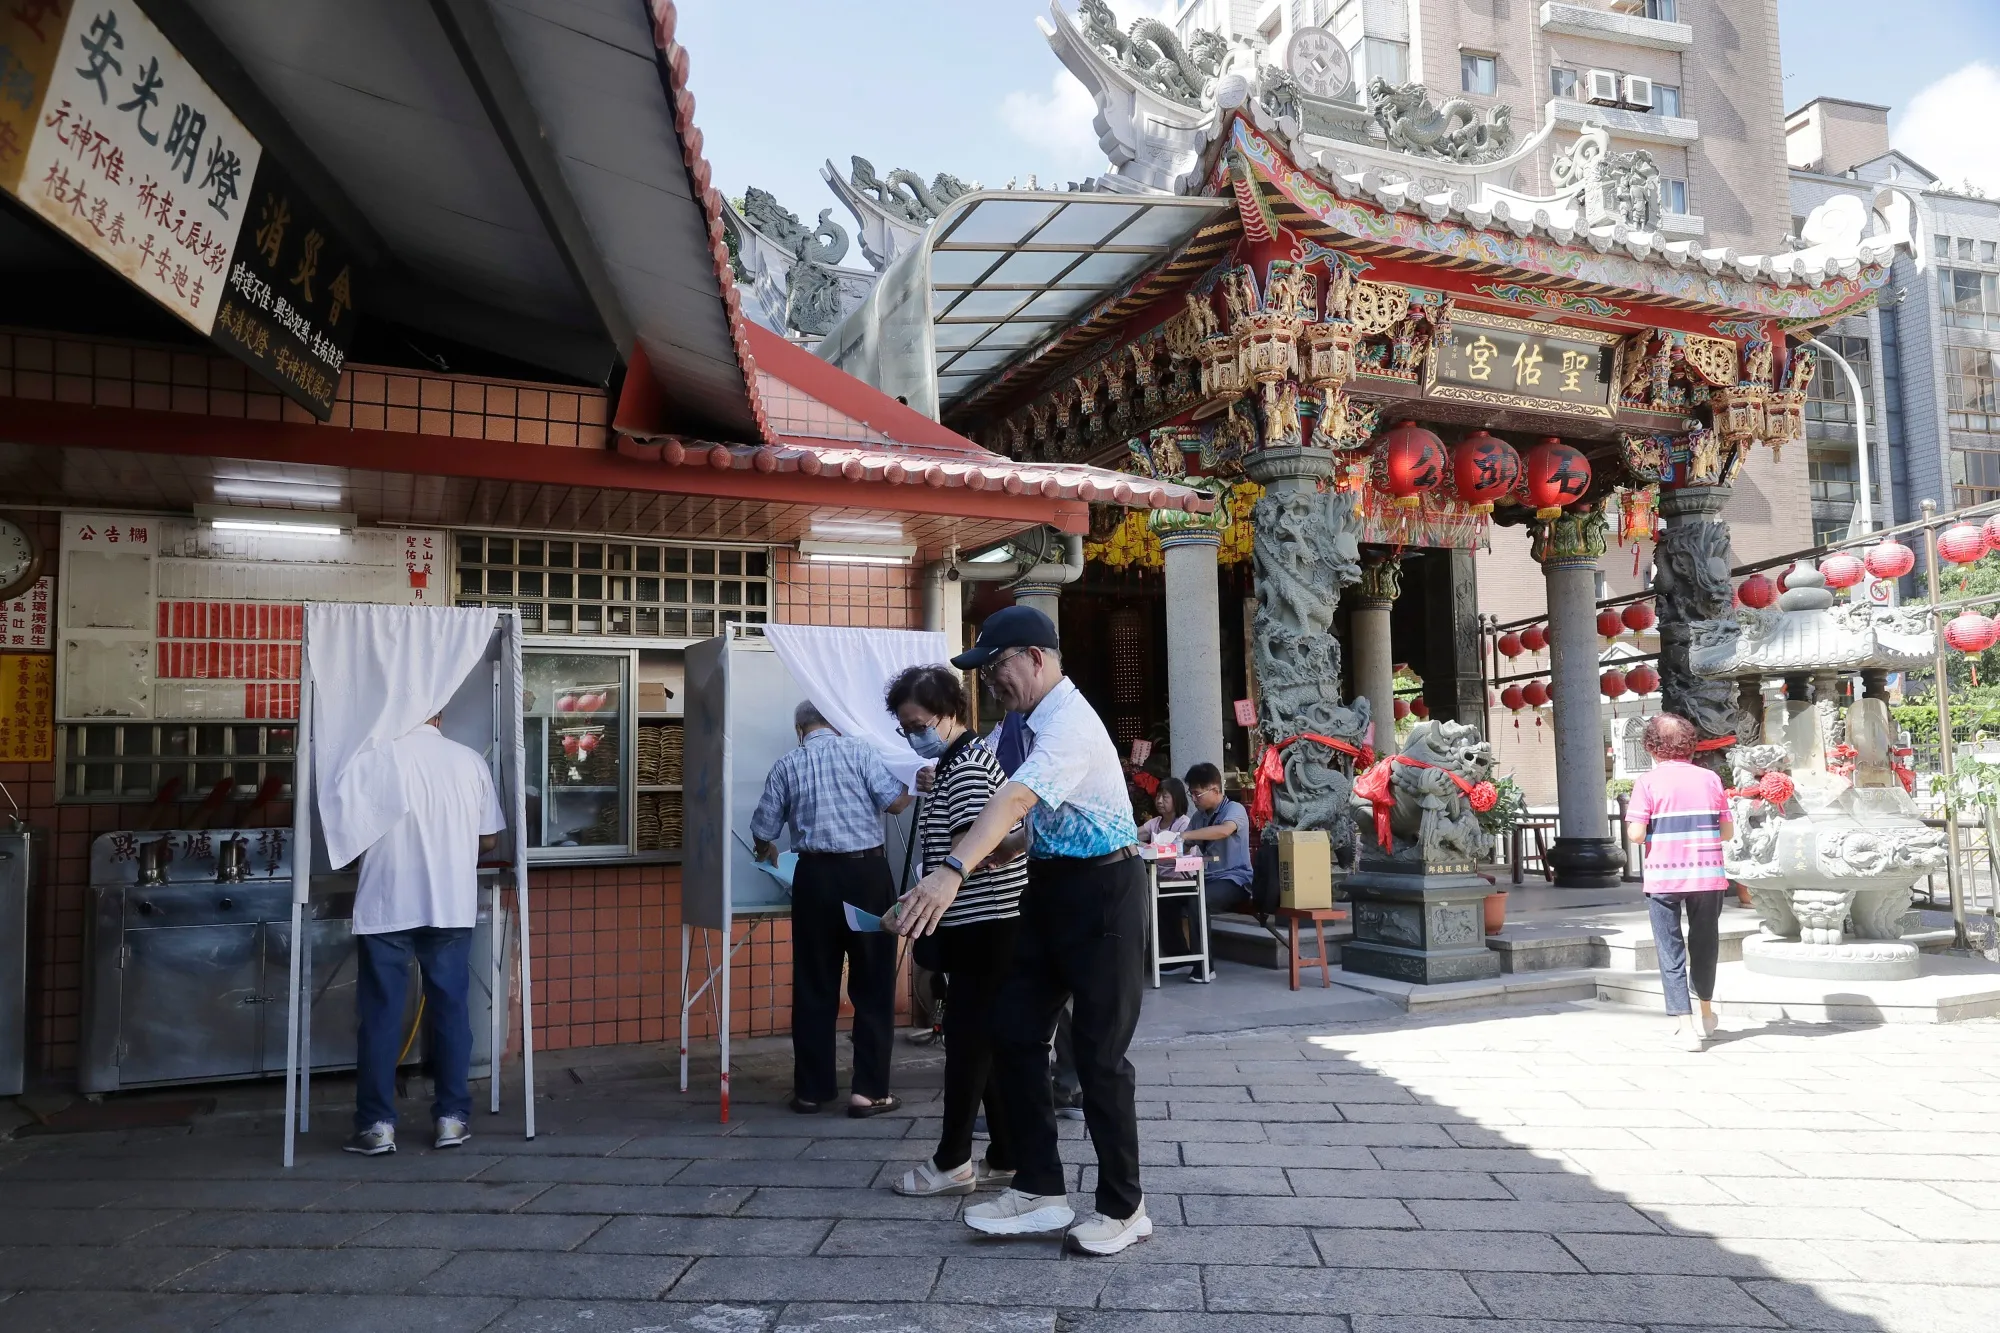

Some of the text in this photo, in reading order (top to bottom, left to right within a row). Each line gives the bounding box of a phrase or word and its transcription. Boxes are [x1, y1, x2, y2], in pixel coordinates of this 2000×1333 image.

[76, 10, 241, 220] 安光明燈
[256, 193, 351, 325] 消災會
[13, 536, 22, 547] 2
[78, 524, 148, 544] 公告欄
[18, 550, 27, 561] 3
[406, 536, 417, 574] 聖佑宮
[415, 589, 423, 600] 月
[12, 596, 26, 645] 亂吐痰
